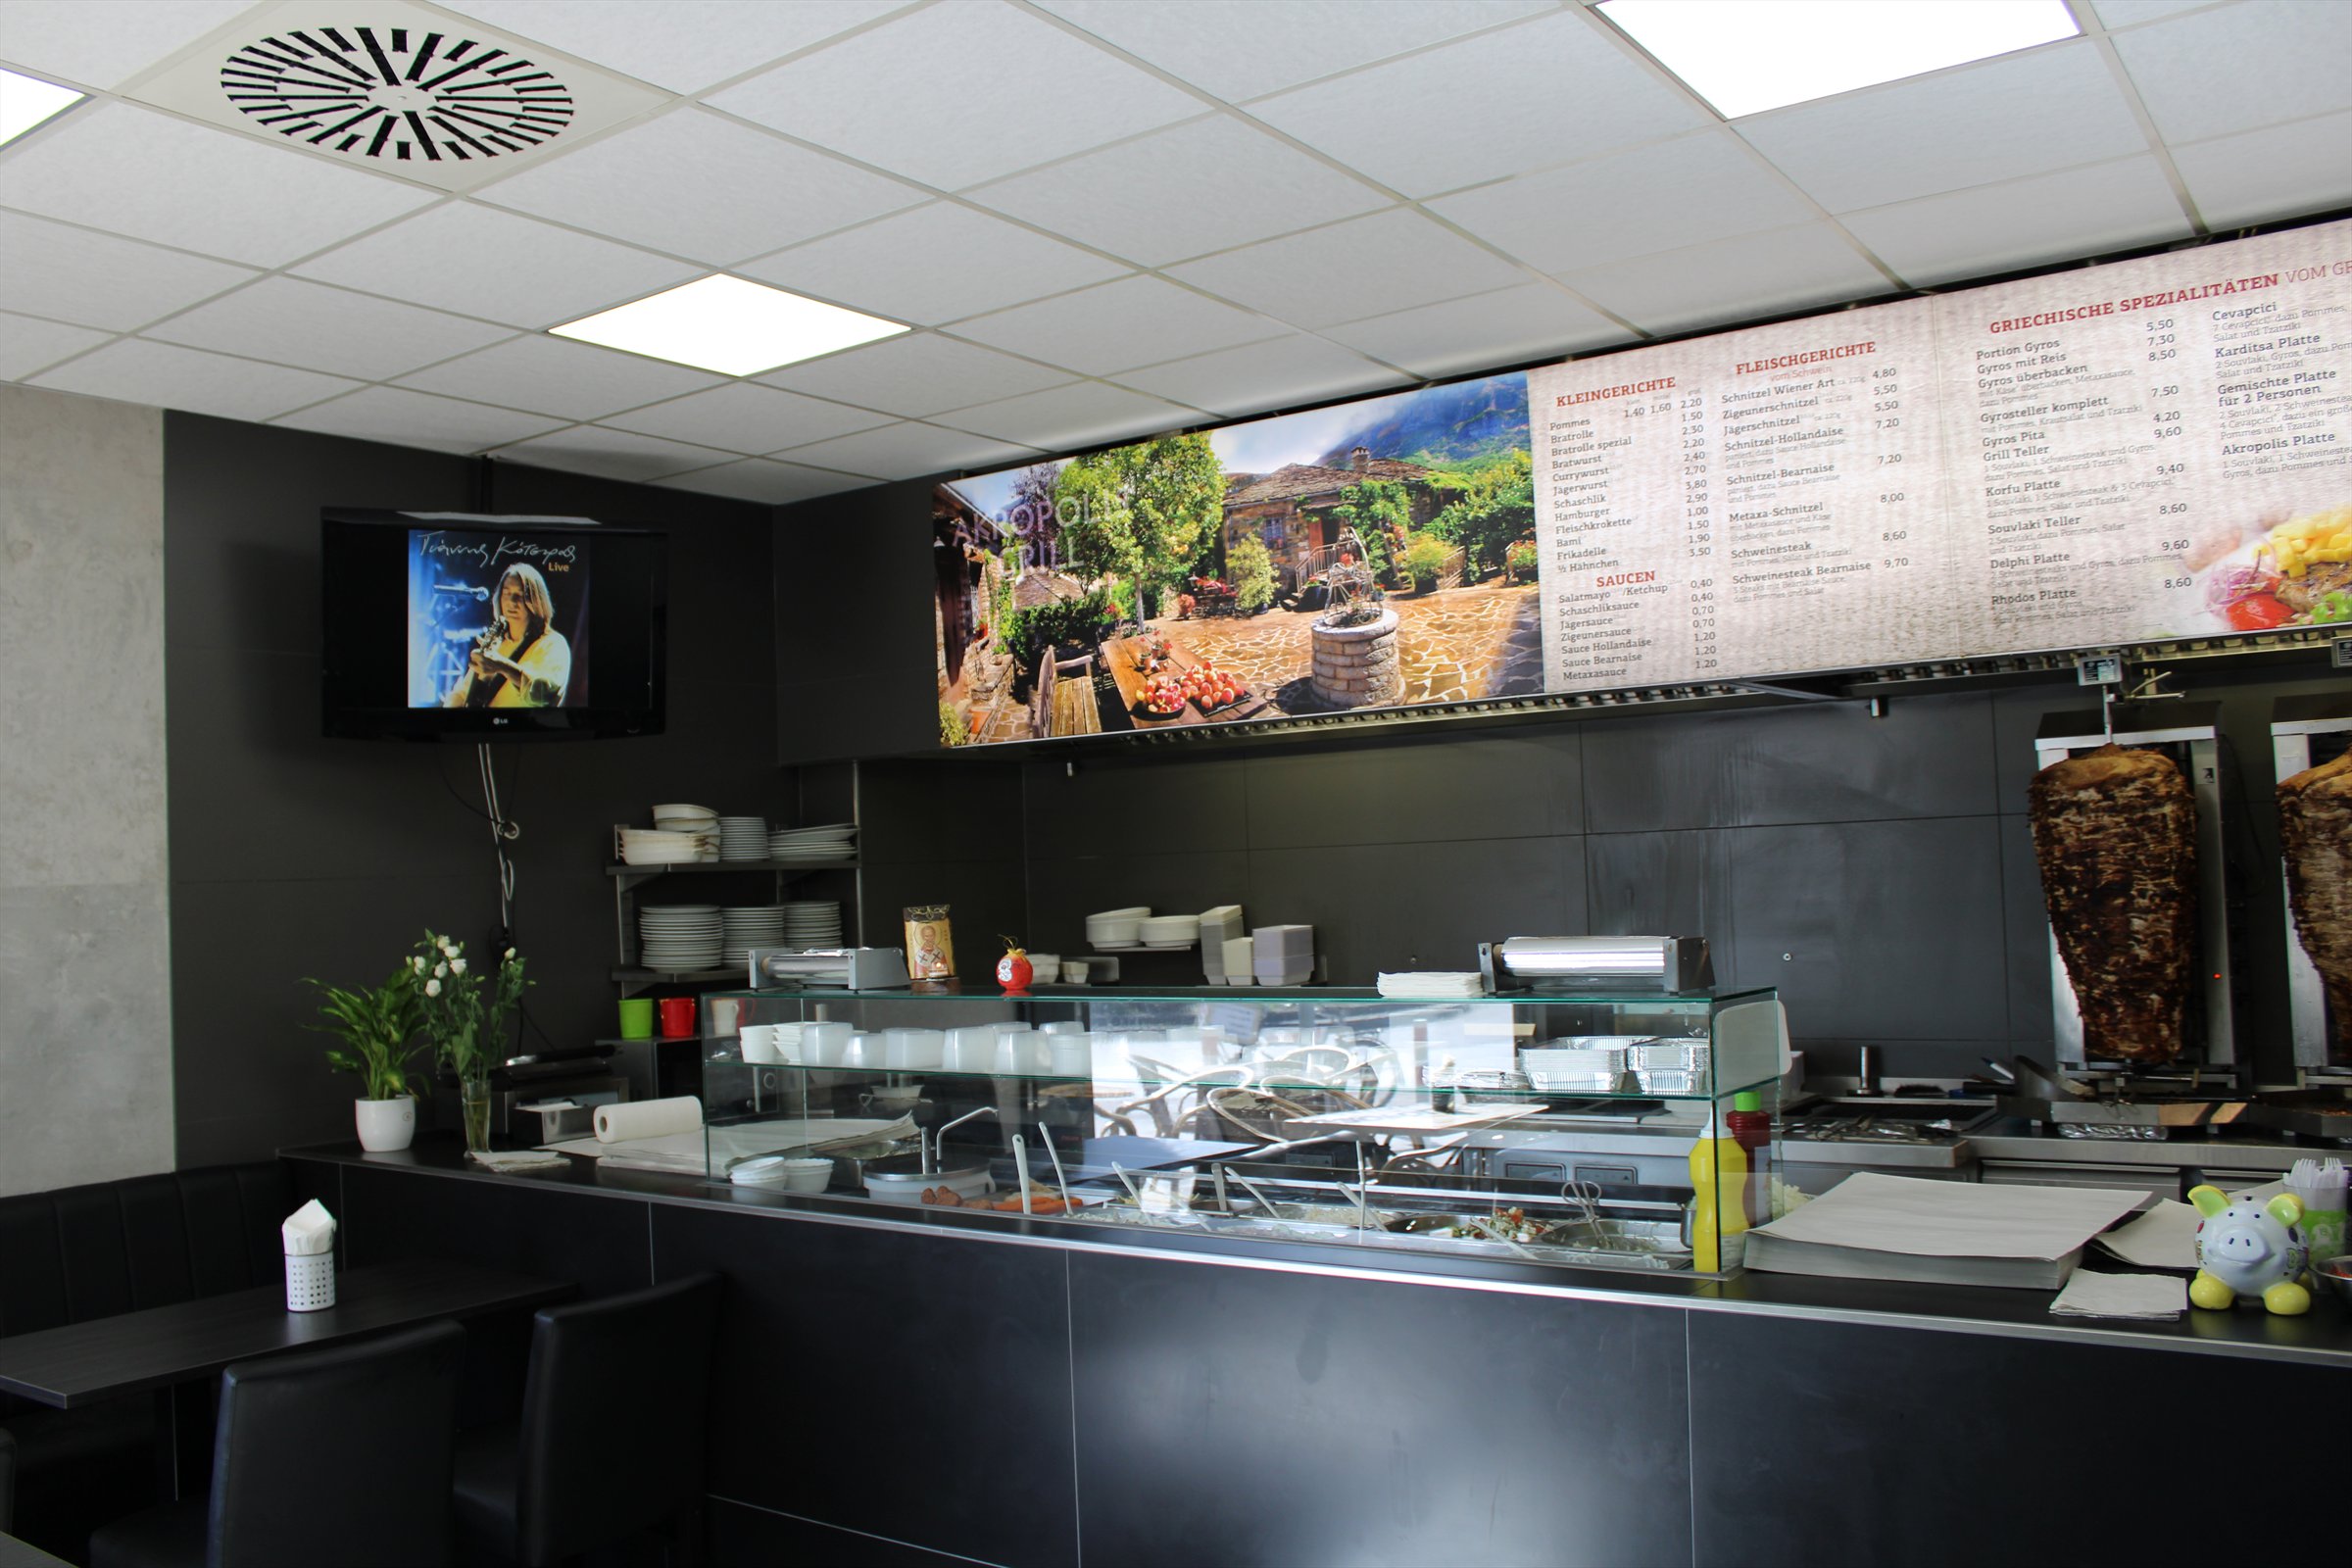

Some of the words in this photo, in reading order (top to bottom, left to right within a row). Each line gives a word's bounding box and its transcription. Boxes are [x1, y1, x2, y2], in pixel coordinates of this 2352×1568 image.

[1990, 302, 2114, 333] GRIECHISCHE
[2120, 273, 2278, 312] SPEZIALITÄTEN
[2285, 265, 2327, 283] VOM
[2213, 302, 2277, 320] Cevapcici
[1977, 347, 2021, 360] Portion
[2025, 340, 2060, 353] Gyros
[2146, 318, 2174, 331] 5,50
[2215, 343, 2274, 358] Karditsa
[2278, 335, 2320, 348] Platte
[1737, 341, 1876, 374] FLEISCHGERICHTE
[1978, 363, 2012, 375] Gyros
[2015, 358, 2036, 368] mit
[2040, 354, 2067, 365] Reis
[2147, 334, 2175, 346] 7,30
[1978, 377, 2013, 389] Gyros
[2016, 366, 2088, 382] überbacken
[2148, 349, 2176, 361] 8,50
[2218, 378, 2289, 394] Gemischte
[2294, 371, 2336, 383] Platte
[1556, 377, 1676, 407] KLEINGERICHTE
[1722, 388, 1771, 404] Schnitzel
[1774, 383, 1813, 395] Wiener
[1817, 379, 1835, 388] Art
[1873, 368, 1896, 378] 4,80
[2219, 397, 2239, 407] für
[2257, 386, 2322, 401] Personen
[1549, 419, 1591, 430] Pommes
[1624, 408, 1644, 418] 1,40
[1650, 403, 1672, 414] 1,60
[1680, 398, 1702, 409] 2,20
[1722, 396, 1819, 419] Zigeunerschnitzel
[1874, 384, 1897, 396] 5,50
[1875, 401, 1899, 412] 5,50
[1981, 407, 2048, 424] Gyrosteller
[2052, 397, 2109, 413] komplett
[1550, 430, 1593, 444] Bratrolle
[1682, 411, 1703, 422] 1,50
[1724, 427, 1843, 452] Schnitzel-Hollandaise
[1875, 417, 1899, 428] 7,20
[1983, 436, 2017, 448] Gyros
[2021, 431, 2045, 441] Pita
[2153, 411, 2180, 422] 4,20
[1551, 443, 1594, 457] Bratrolle
[1597, 436, 1632, 451] spezial
[1552, 456, 1601, 469] Bratwurst
[1683, 438, 1704, 449] 2,20
[1984, 449, 2010, 462] Grill
[2013, 446, 2049, 457] Teller
[2154, 426, 2181, 439] 9,60
[2222, 439, 2288, 455] Akropolis
[2293, 434, 2335, 446] Platte
[1552, 467, 1609, 482] Currywurst
[1684, 452, 1705, 462] 2,40
[1726, 465, 1835, 485] Schnitzel-Bearnaise
[1878, 454, 1902, 465] 7,20
[1985, 484, 2021, 497] Korfu
[2024, 481, 2060, 492] Platte
[2156, 464, 2184, 475] 9,40
[1553, 494, 1606, 509] Schaschlik
[1554, 509, 1610, 521] Hamburger
[1686, 493, 1708, 504] 2,90
[1729, 502, 1823, 522] Metaxa-Schnitzel
[1881, 492, 1904, 504] 8,00
[1555, 518, 1632, 534] Fleischkrokette
[1688, 506, 1708, 516] 1,00
[1988, 520, 2040, 534] Souvlaki
[2044, 516, 2082, 527] Teller
[2159, 503, 2187, 514] 8,60
[1556, 537, 1581, 547] Bami
[1688, 519, 1709, 530] 1,50
[1557, 547, 1606, 561] Frikadelle
[1689, 533, 1710, 544] 1,90
[1731, 541, 1811, 559] Schweinesteak
[1883, 530, 1907, 541] 8,60
[1689, 547, 1711, 557] 3,50
[1990, 557, 2030, 569] Delphi
[2034, 554, 2070, 564] Platte
[2162, 539, 2189, 551] 9,60
[548, 562, 570, 572] Live
[1596, 570, 1655, 587] SAUCEN
[1733, 567, 1813, 584] Schweinesteak
[1816, 563, 1871, 575] Bearnaise
[1884, 558, 1909, 568] 9,70
[1558, 592, 1611, 604] Salatmayo
[1690, 578, 1713, 589] 0,40
[1559, 603, 1640, 616] Schaschliksauce
[1690, 592, 1714, 602] 0,40
[1991, 593, 2035, 605] Rhodos
[2038, 590, 2077, 600] Platte
[2165, 577, 2191, 588] 8,60
[1560, 628, 1632, 643] Zigeunersauce
[1592, 638, 1652, 651] Hollandaise
[1694, 631, 1716, 642] 1,20
[1593, 653, 1642, 664] Bearnaise
[1694, 645, 1716, 656] 1,20
[1563, 668, 1627, 680] Metaxasauce
[1695, 660, 1717, 668] 1,20
